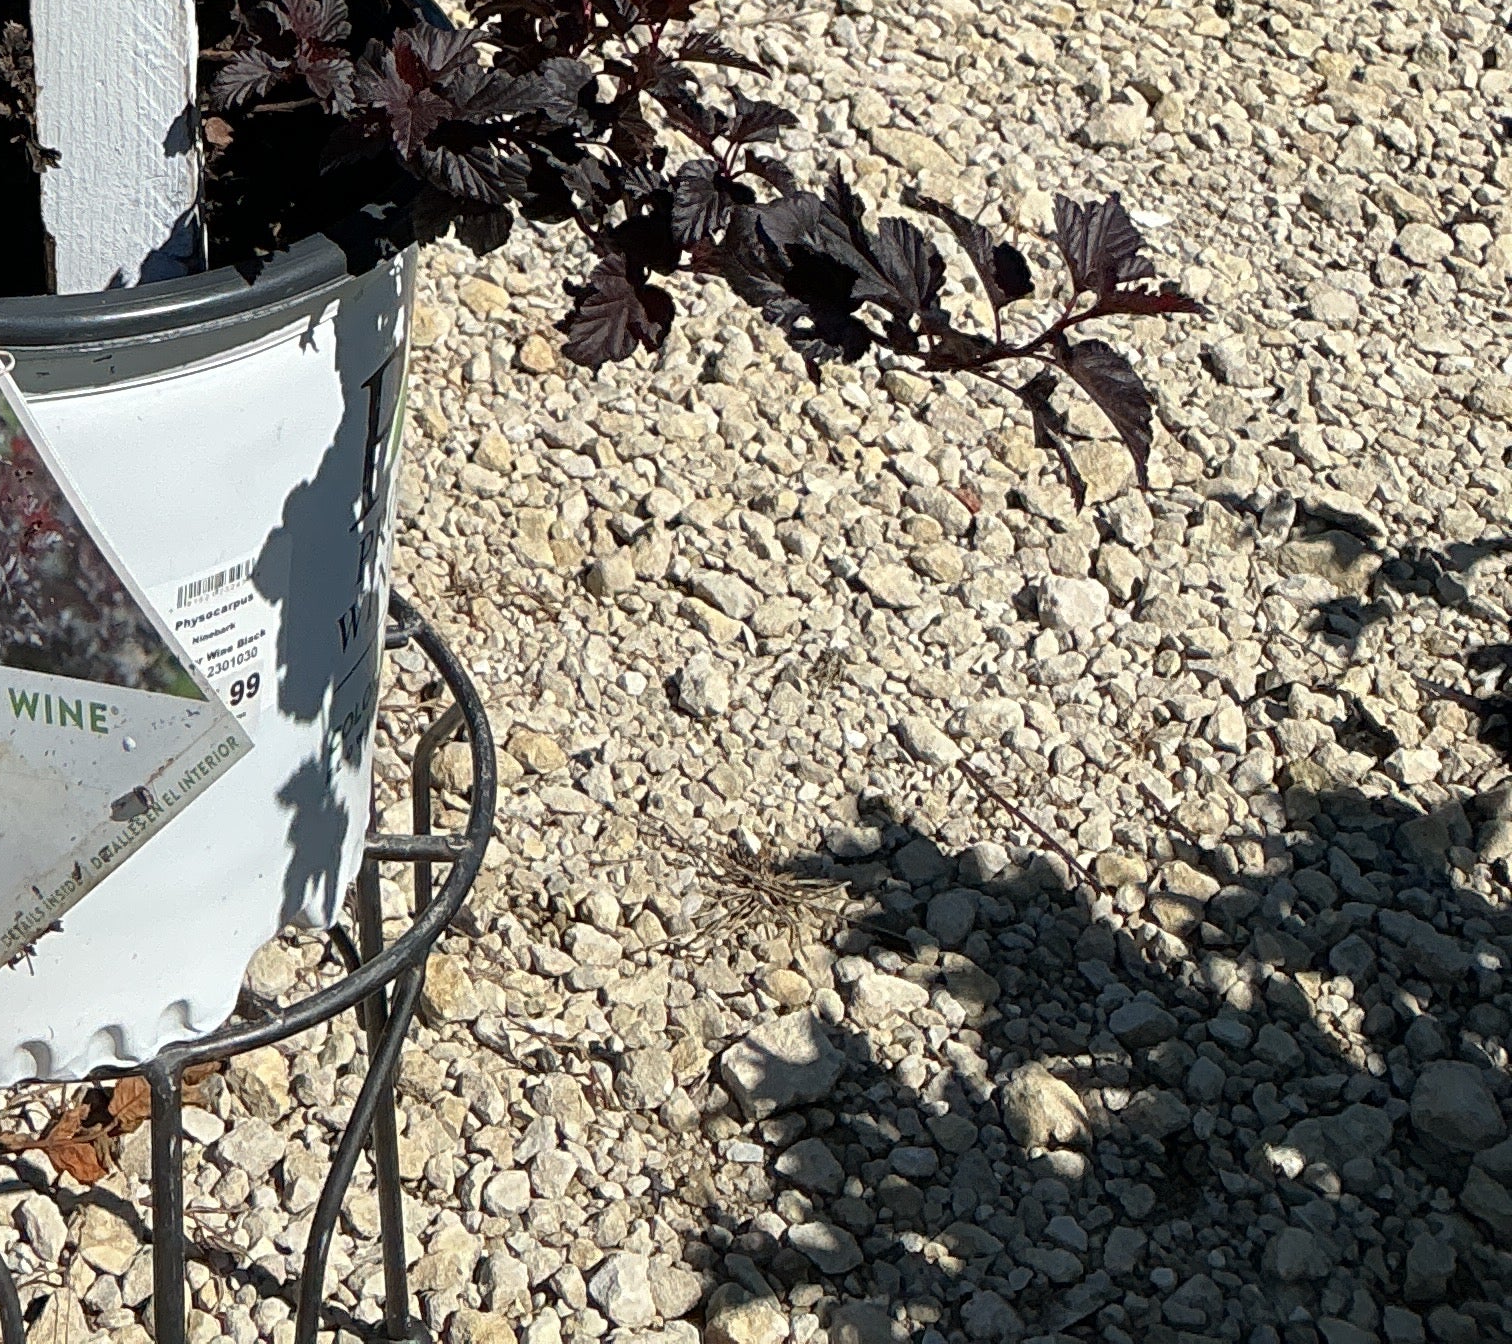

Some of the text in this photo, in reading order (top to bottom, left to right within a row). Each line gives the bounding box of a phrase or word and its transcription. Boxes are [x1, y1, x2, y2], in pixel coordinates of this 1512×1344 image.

[175, 593, 254, 631] Physocarpus
[192, 622, 236, 645] Ninebark
[236, 628, 266, 649] Black
[207, 645, 258, 678] 2301030
[230, 671, 261, 707] 99
[162, 787, 181, 807] EL
[178, 735, 240, 793] INTERIOR
